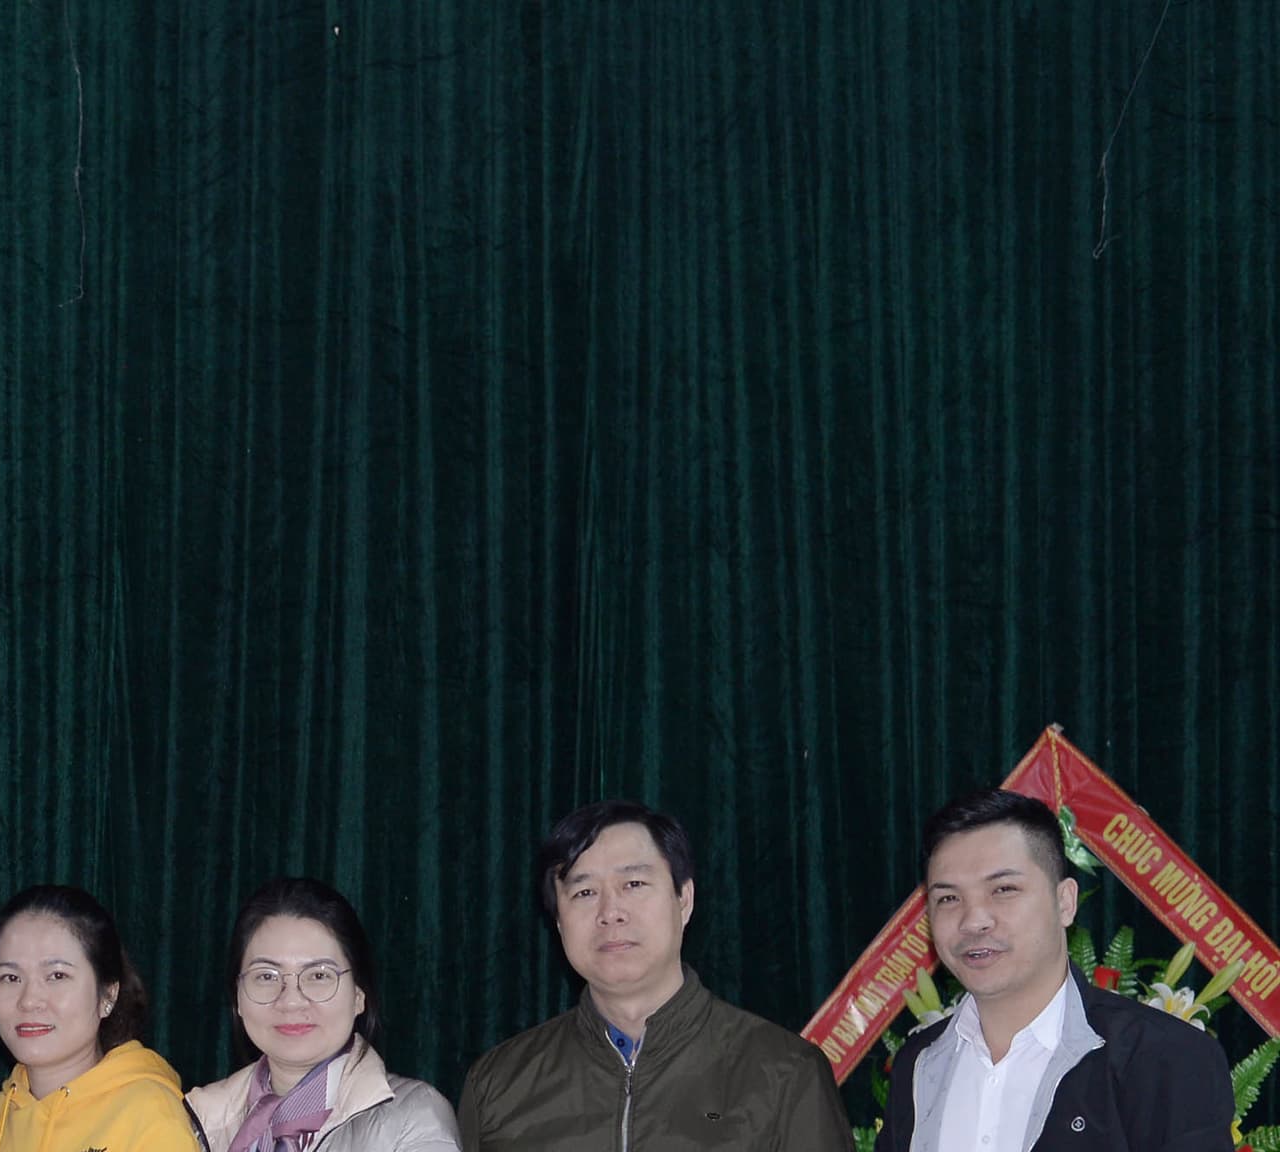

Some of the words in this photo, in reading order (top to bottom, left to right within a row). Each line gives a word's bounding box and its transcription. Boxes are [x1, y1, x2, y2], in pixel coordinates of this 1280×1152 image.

[1103, 813, 1162, 875] CHÚC
[1149, 860, 1218, 932] MỪNG
[1203, 916, 1252, 965] ĐẠI
[1242, 950, 1280, 1000] HỘI
[875, 949, 917, 991] TRẬN
